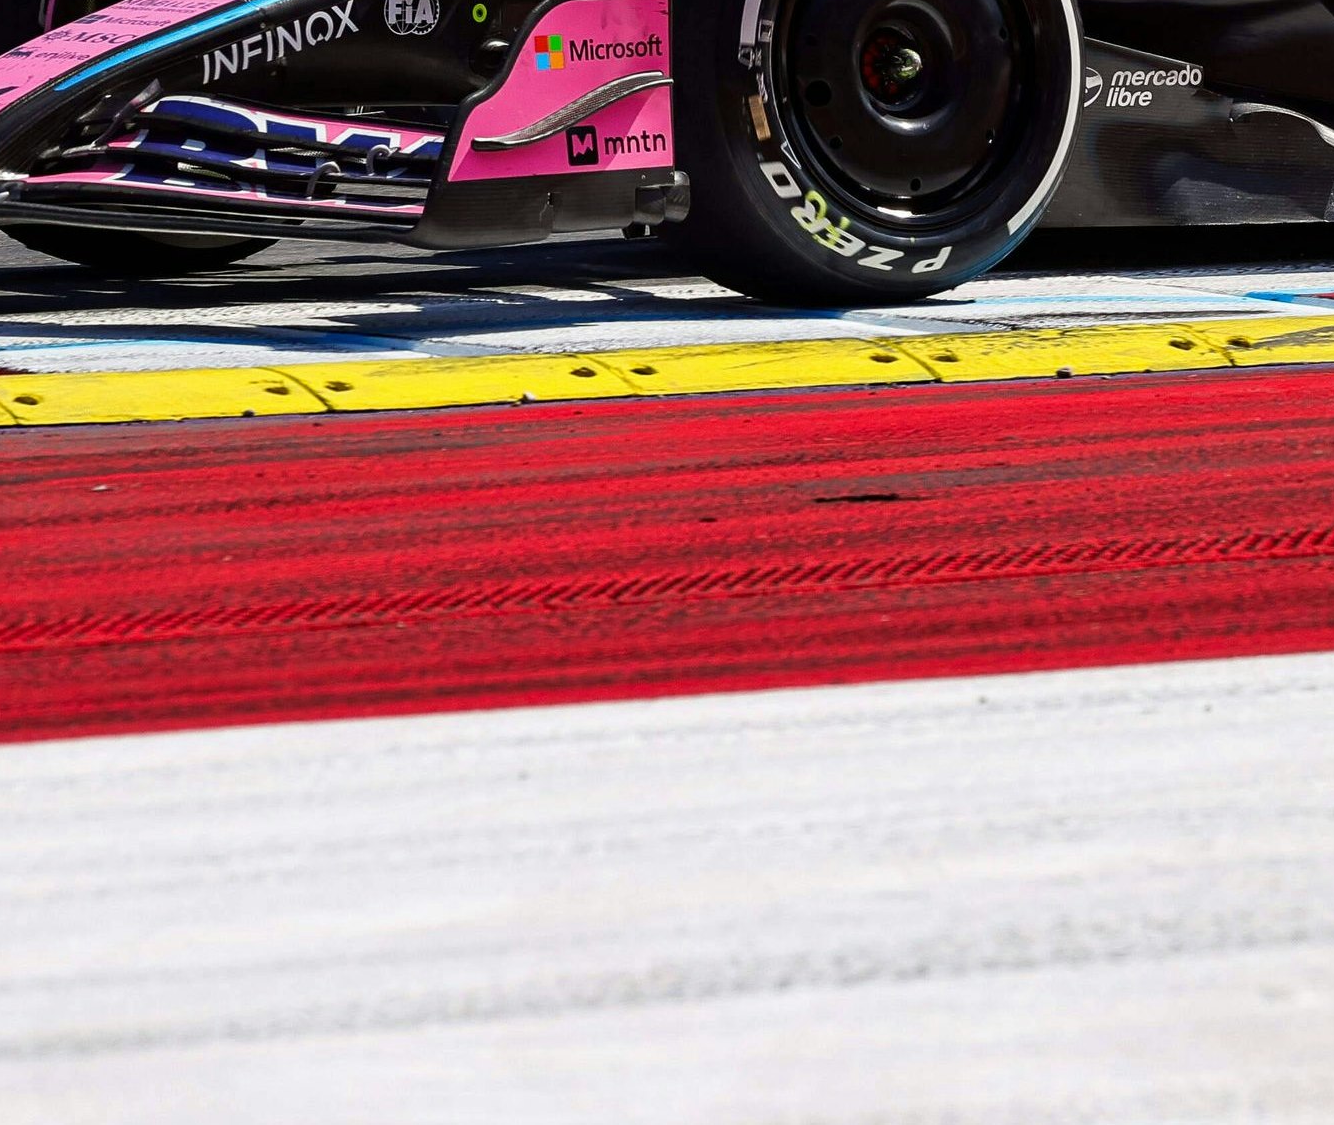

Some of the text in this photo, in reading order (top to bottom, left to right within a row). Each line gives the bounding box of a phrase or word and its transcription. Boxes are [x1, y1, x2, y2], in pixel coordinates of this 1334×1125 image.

[103, 15, 171, 27] Microsoft
[69, 31, 138, 45] MSC
[201, 0, 360, 84] INFINOX
[568, 37, 663, 64] Microsoft
[1111, 65, 1203, 88] mercado
[1105, 85, 1154, 109] libre
[604, 131, 667, 156] mntn
[759, 161, 953, 274] P ZERO
